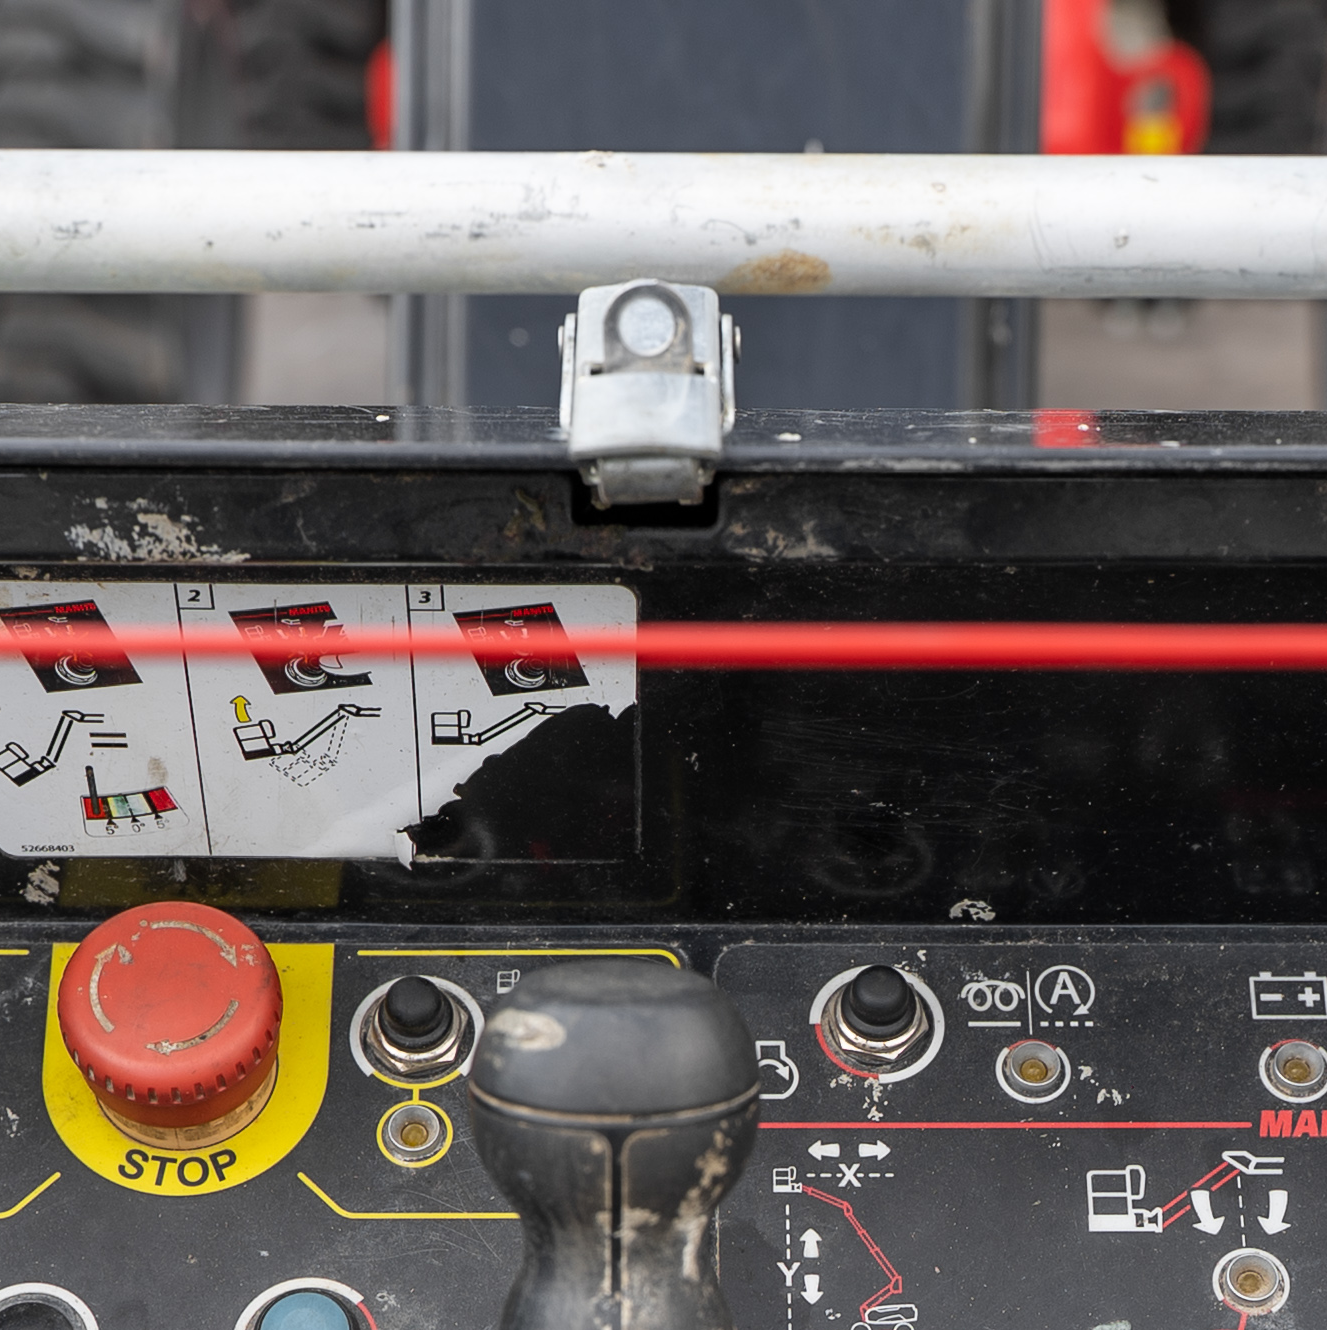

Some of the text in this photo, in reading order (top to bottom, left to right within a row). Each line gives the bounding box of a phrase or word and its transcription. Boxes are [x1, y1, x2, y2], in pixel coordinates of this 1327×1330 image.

[187, 589, 201, 602] 2
[418, 590, 432, 604] 3
[21, 844, 75, 852] 52668403
[1049, 971, 1082, 1005] A
[118, 1148, 237, 1187] STOP
[838, 1163, 862, 1188] X
[776, 1261, 801, 1287] Y
